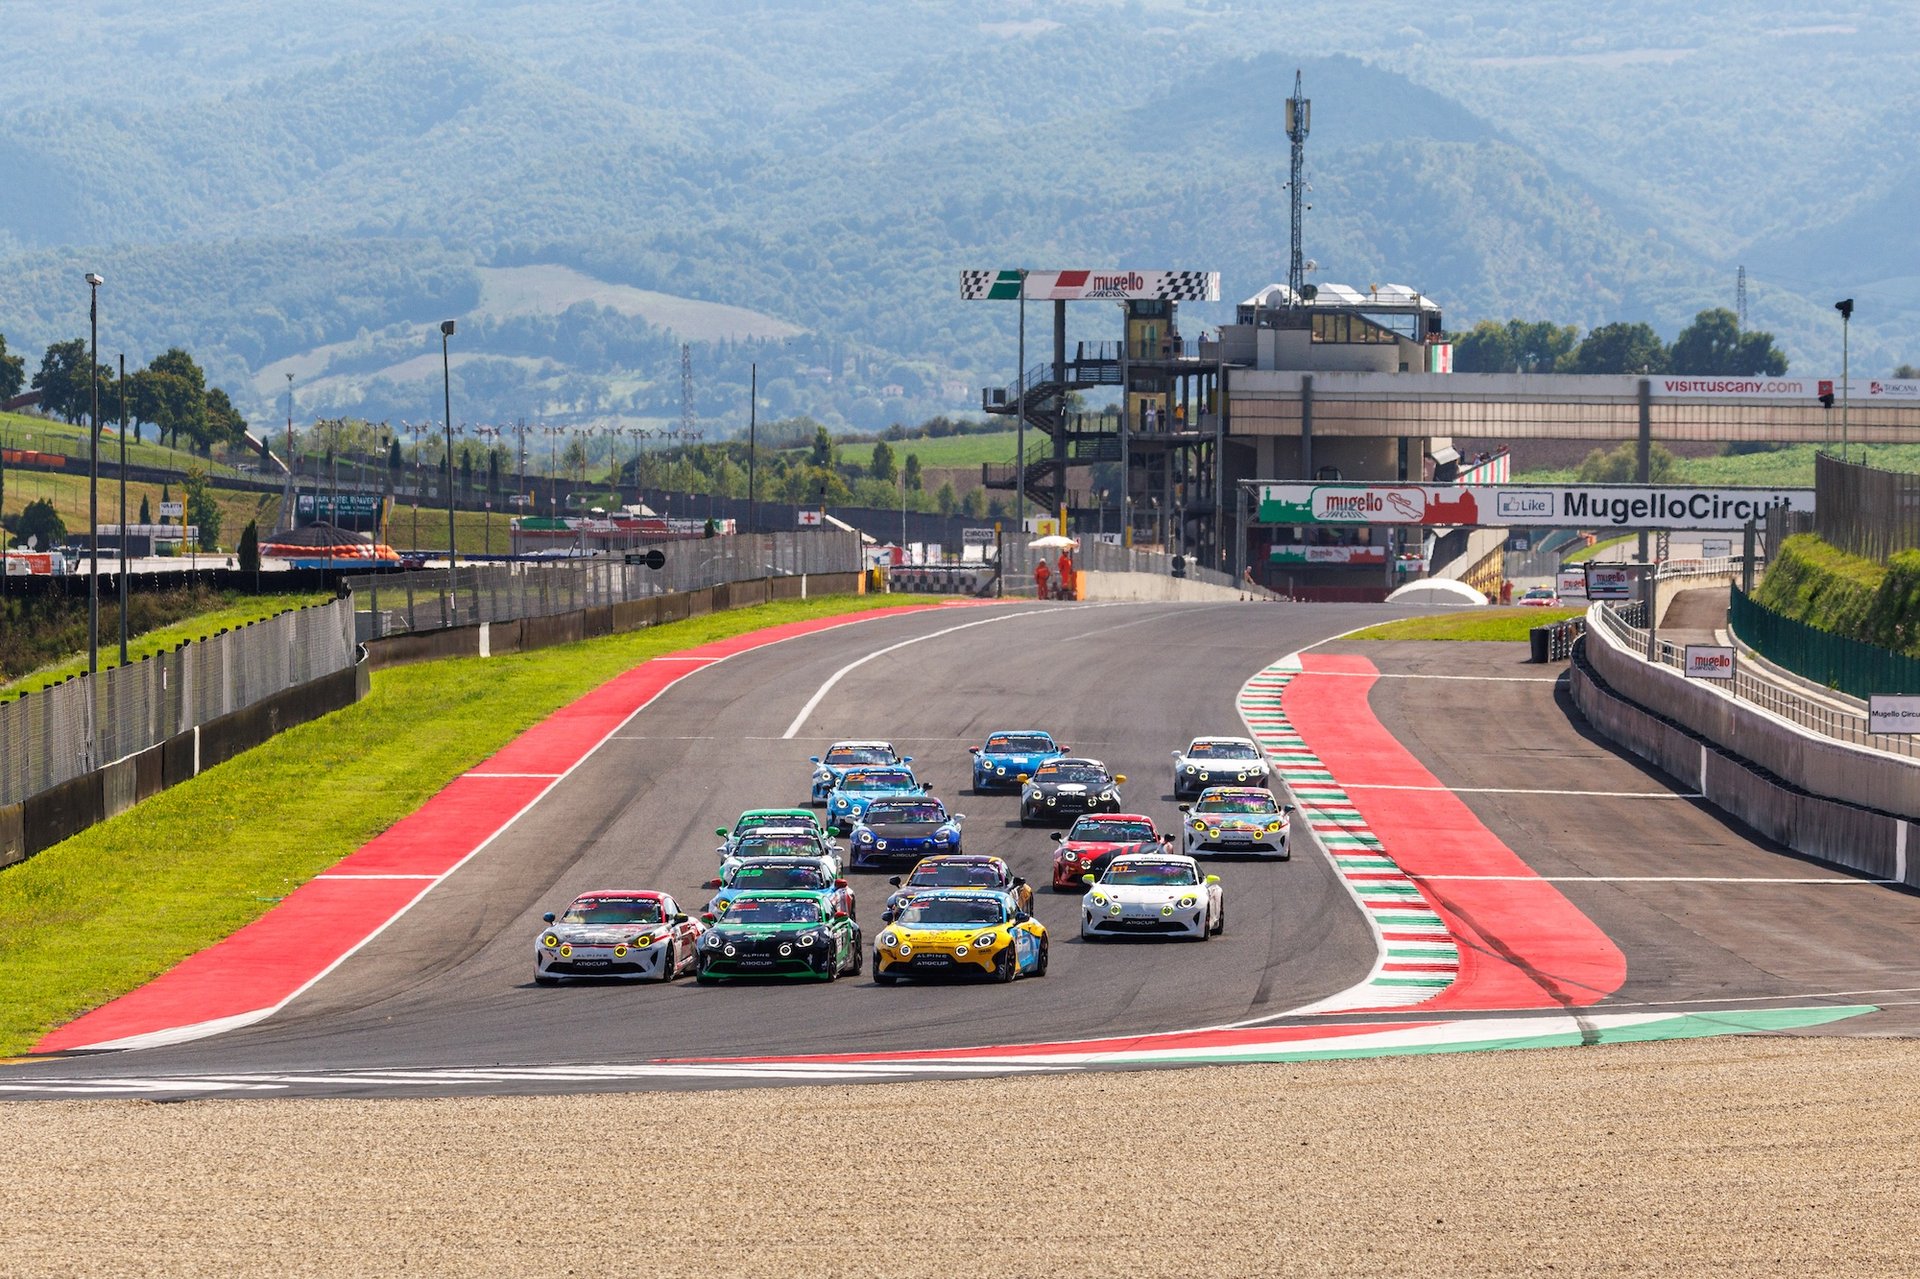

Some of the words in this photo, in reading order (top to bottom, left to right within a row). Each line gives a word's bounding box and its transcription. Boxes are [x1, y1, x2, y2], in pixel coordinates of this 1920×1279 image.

[1093, 272, 1143, 291] mugello
[1326, 492, 1383, 511] mugello
[1521, 499, 1546, 511] Like
[1564, 492, 1792, 524] MugelloCircuit
[1694, 654, 1730, 668] mugello
[1871, 710, 1900, 718] Mugello
